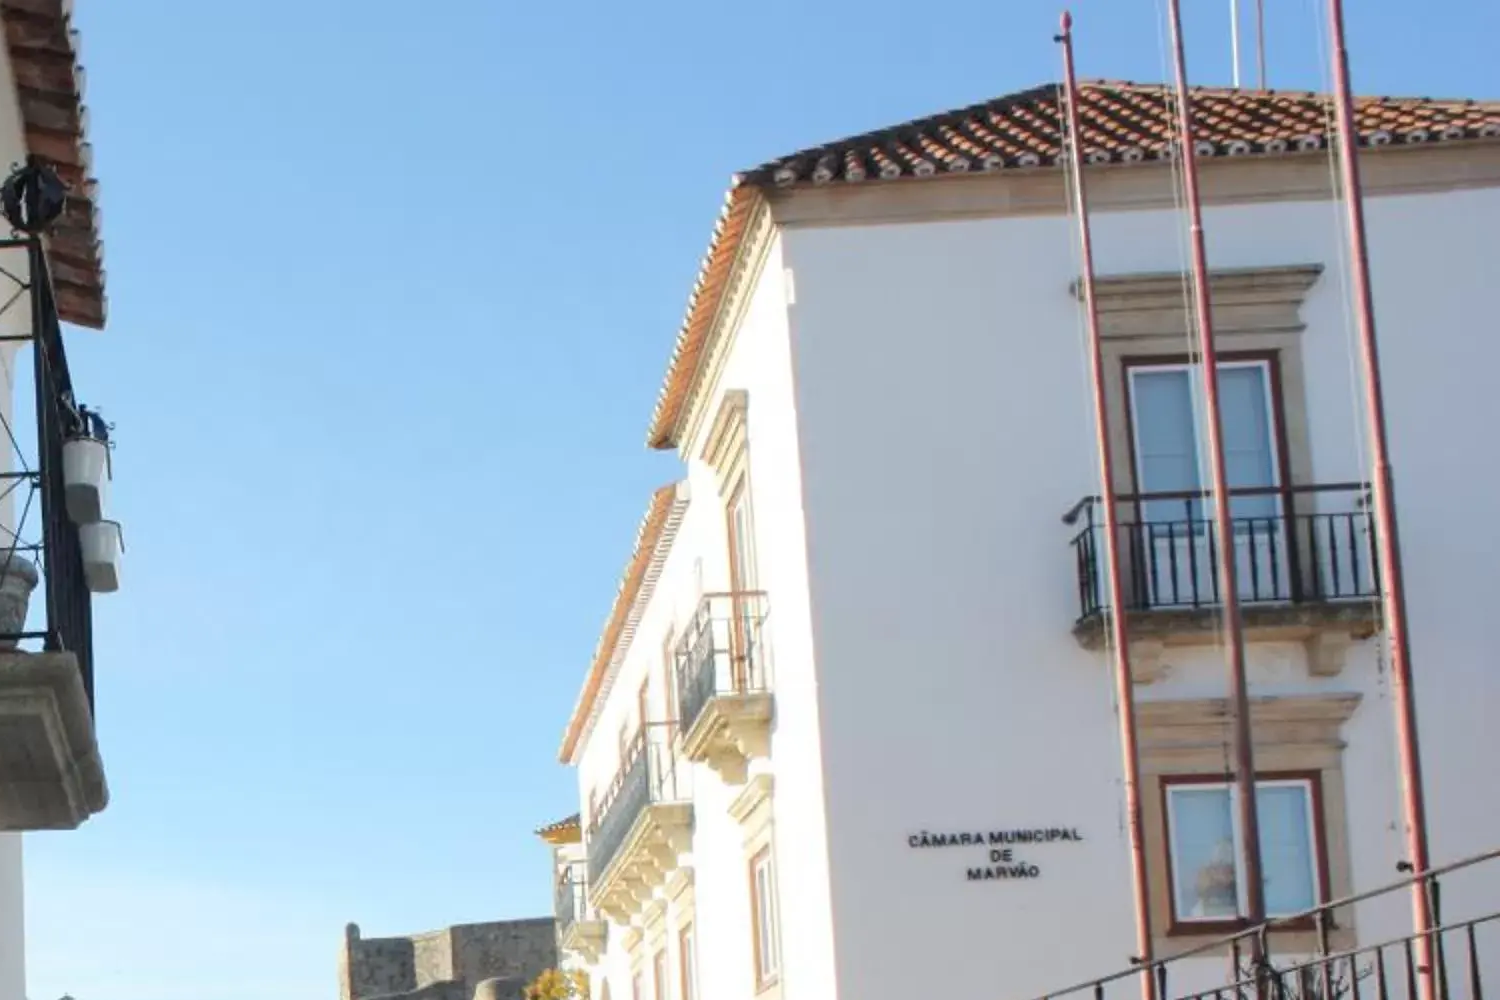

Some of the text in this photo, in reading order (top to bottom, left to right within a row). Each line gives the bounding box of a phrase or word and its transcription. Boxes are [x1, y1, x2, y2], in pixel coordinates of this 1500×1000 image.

[908, 828, 1083, 847] CÂMARA MUNICIPAL
[989, 848, 1012, 862] DE
[966, 862, 1040, 880] MARVÃO
